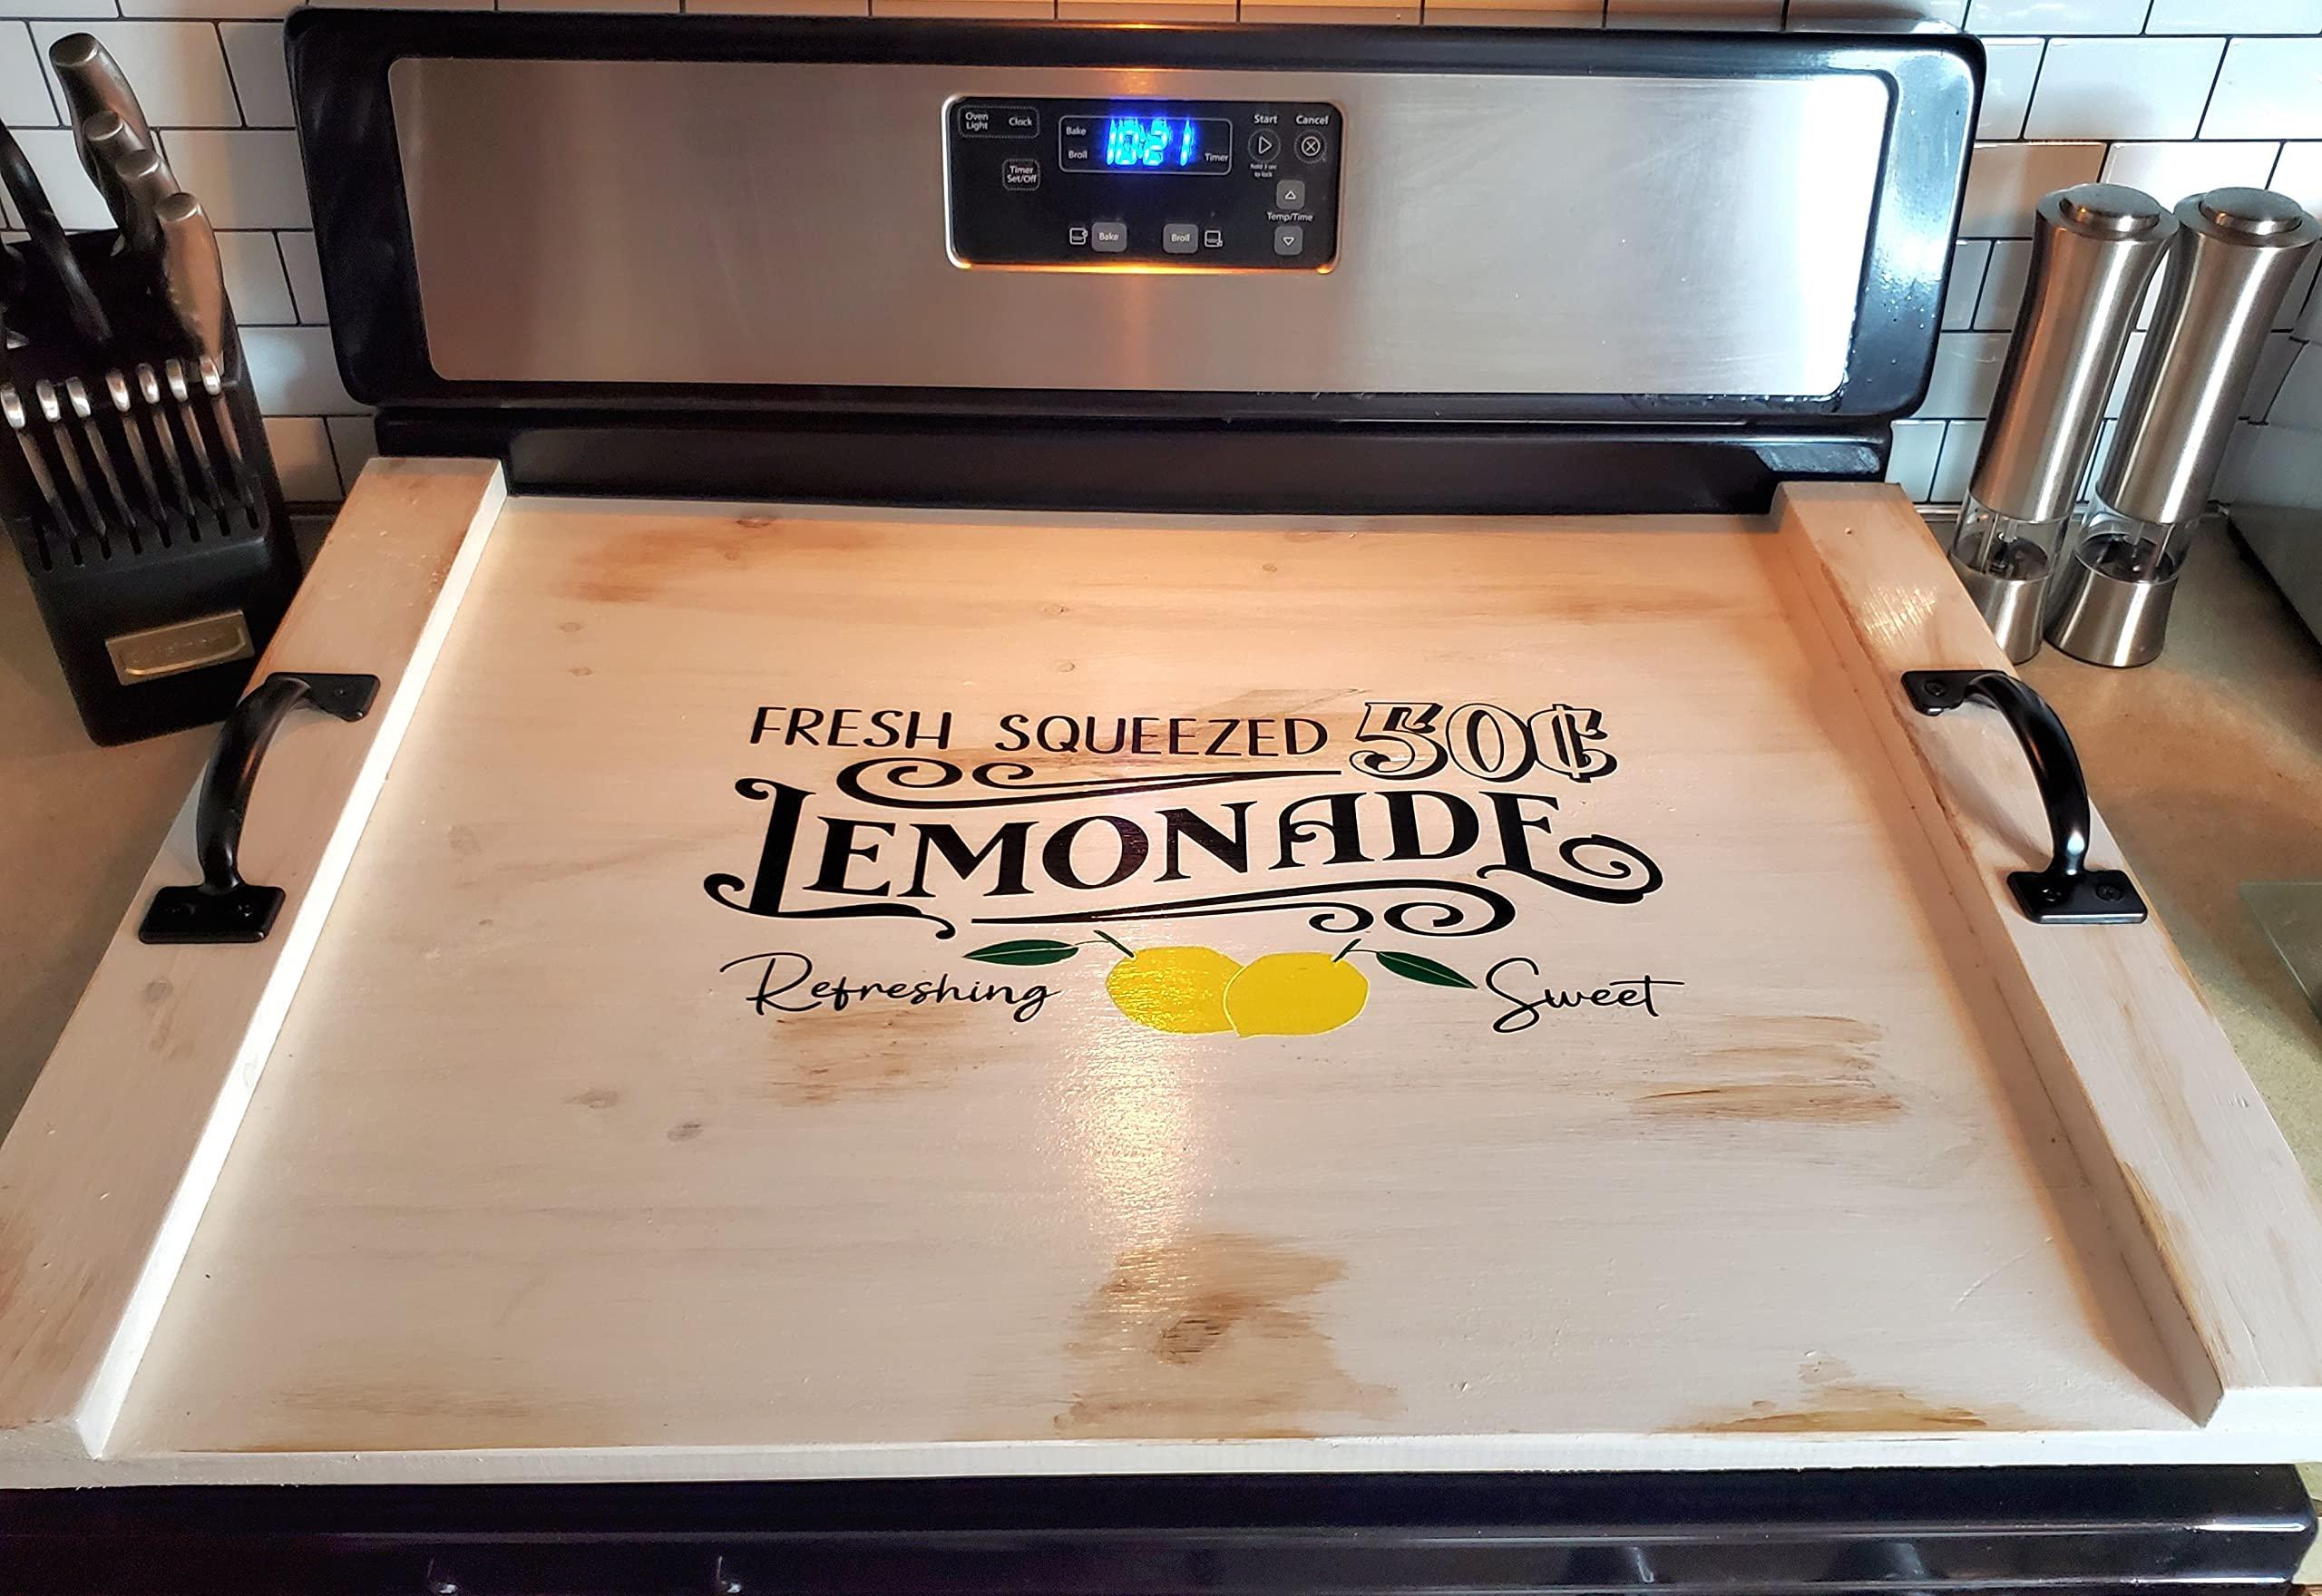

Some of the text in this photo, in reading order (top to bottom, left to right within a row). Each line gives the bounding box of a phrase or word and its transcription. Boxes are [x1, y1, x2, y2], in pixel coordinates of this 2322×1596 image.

[965, 112, 989, 122] Oven
[1009, 117, 1032, 126] Clock
[1254, 114, 1278, 124] Start
[1295, 115, 1329, 125] Cancel
[966, 122, 988, 131] Light
[1066, 127, 1087, 136] Bake
[1068, 151, 1088, 160] Broil
[1205, 153, 1229, 162] Timer
[1009, 165, 1034, 174] Timer
[1007, 174, 1037, 183] Set/Off
[1267, 211, 1313, 223] Temp/Time
[1098, 231, 1119, 241] Bake
[1171, 232, 1191, 243] Broil
[750, 706, 952, 750] FRESH
[995, 714, 1328, 757] SQUEEZED
[703, 777, 1663, 940] LEMONADE
[719, 951, 1061, 1023] Refreshing
[1485, 957, 1685, 1034] Sweet
